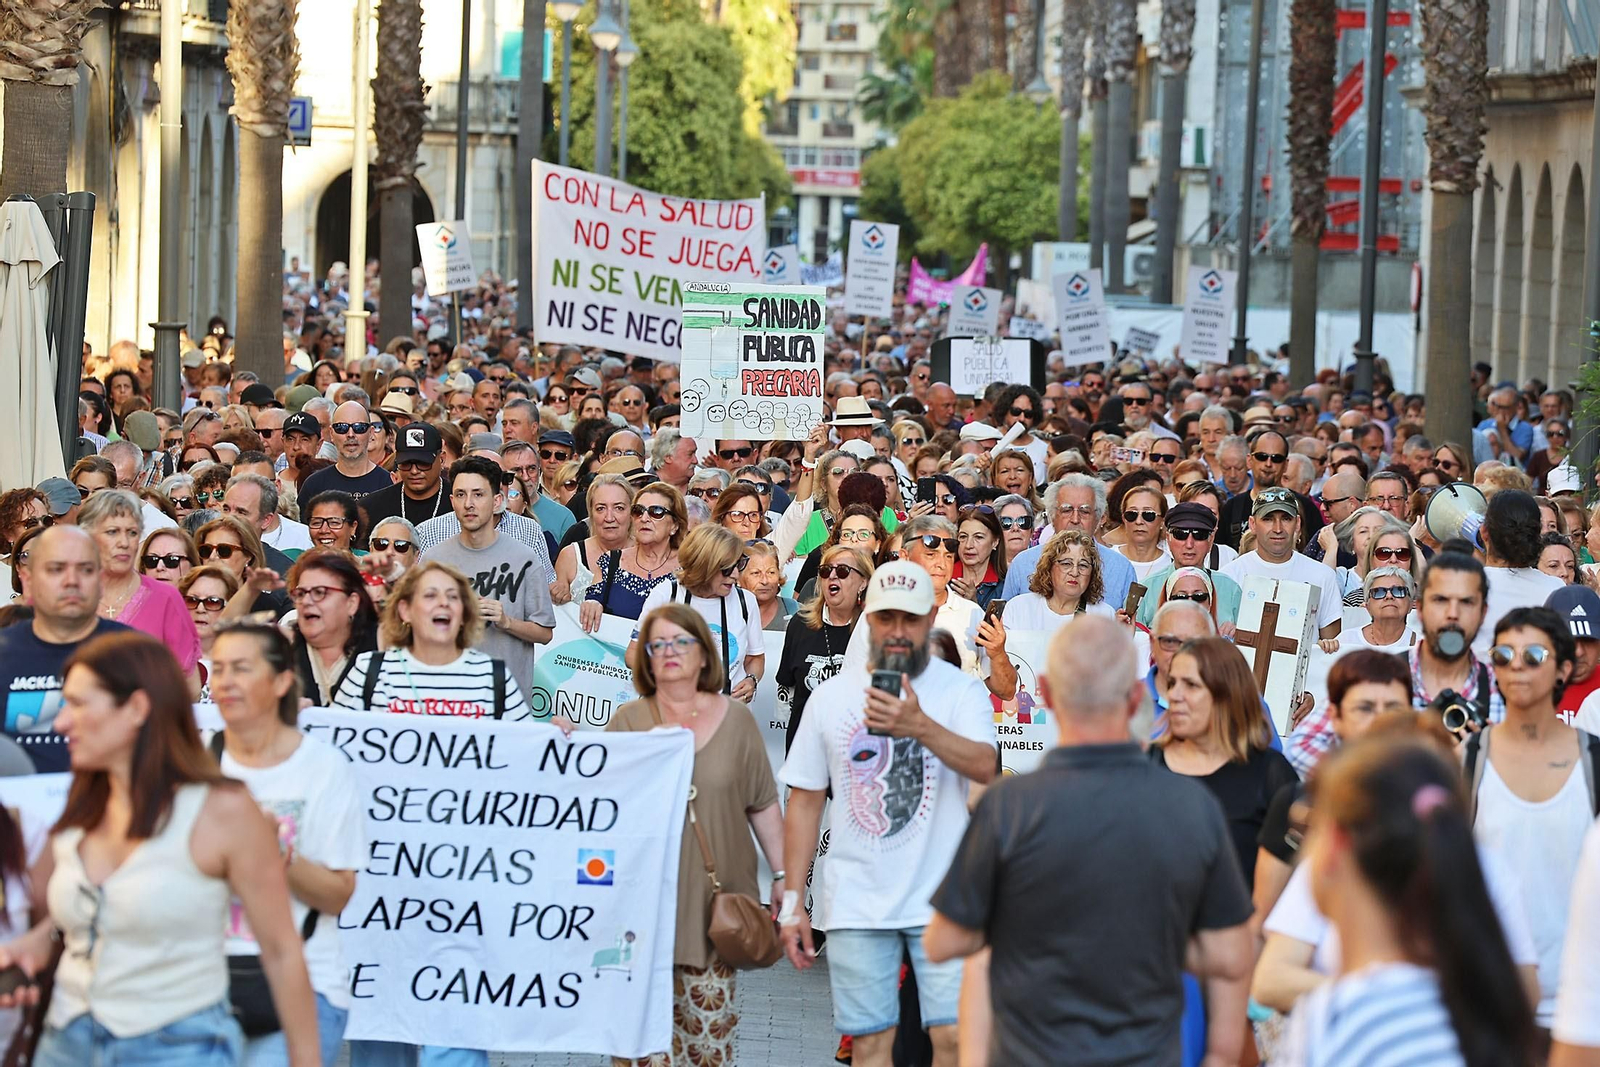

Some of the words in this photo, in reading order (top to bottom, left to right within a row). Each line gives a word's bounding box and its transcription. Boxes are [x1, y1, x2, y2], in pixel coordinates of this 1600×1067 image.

[544, 172, 600, 208] CON
[610, 187, 647, 217] LA
[659, 197, 754, 231] SALUD
[574, 219, 610, 250] NO
[620, 227, 657, 259] SE
[668, 237, 762, 279] JUEGA,
[435, 264, 471, 274] ENCIAS
[552, 258, 579, 289] NI
[589, 264, 625, 295] SE
[547, 299, 575, 329] NI
[581, 304, 617, 335] SE
[625, 311, 682, 350] NEG
[743, 297, 821, 330] SANIDAD
[743, 331, 816, 362] PÚBLICA
[742, 368, 822, 397] PRECARIA
[880, 575, 917, 590] 1933
[554, 659, 587, 672] SANIDAD
[556, 654, 599, 669] ONUBENSES
[600, 664, 628, 676] UNIDOS
[532, 686, 625, 727] ONU
[769, 721, 789, 730] FAL
[994, 725, 1023, 736] ERAS
[538, 739, 608, 778] NO
[368, 786, 619, 832] SEGURIDAD
[356, 840, 536, 885] ENCIAS
[509, 902, 594, 941] POR
[350, 962, 380, 998] E
[411, 966, 583, 1009] CAMAS
